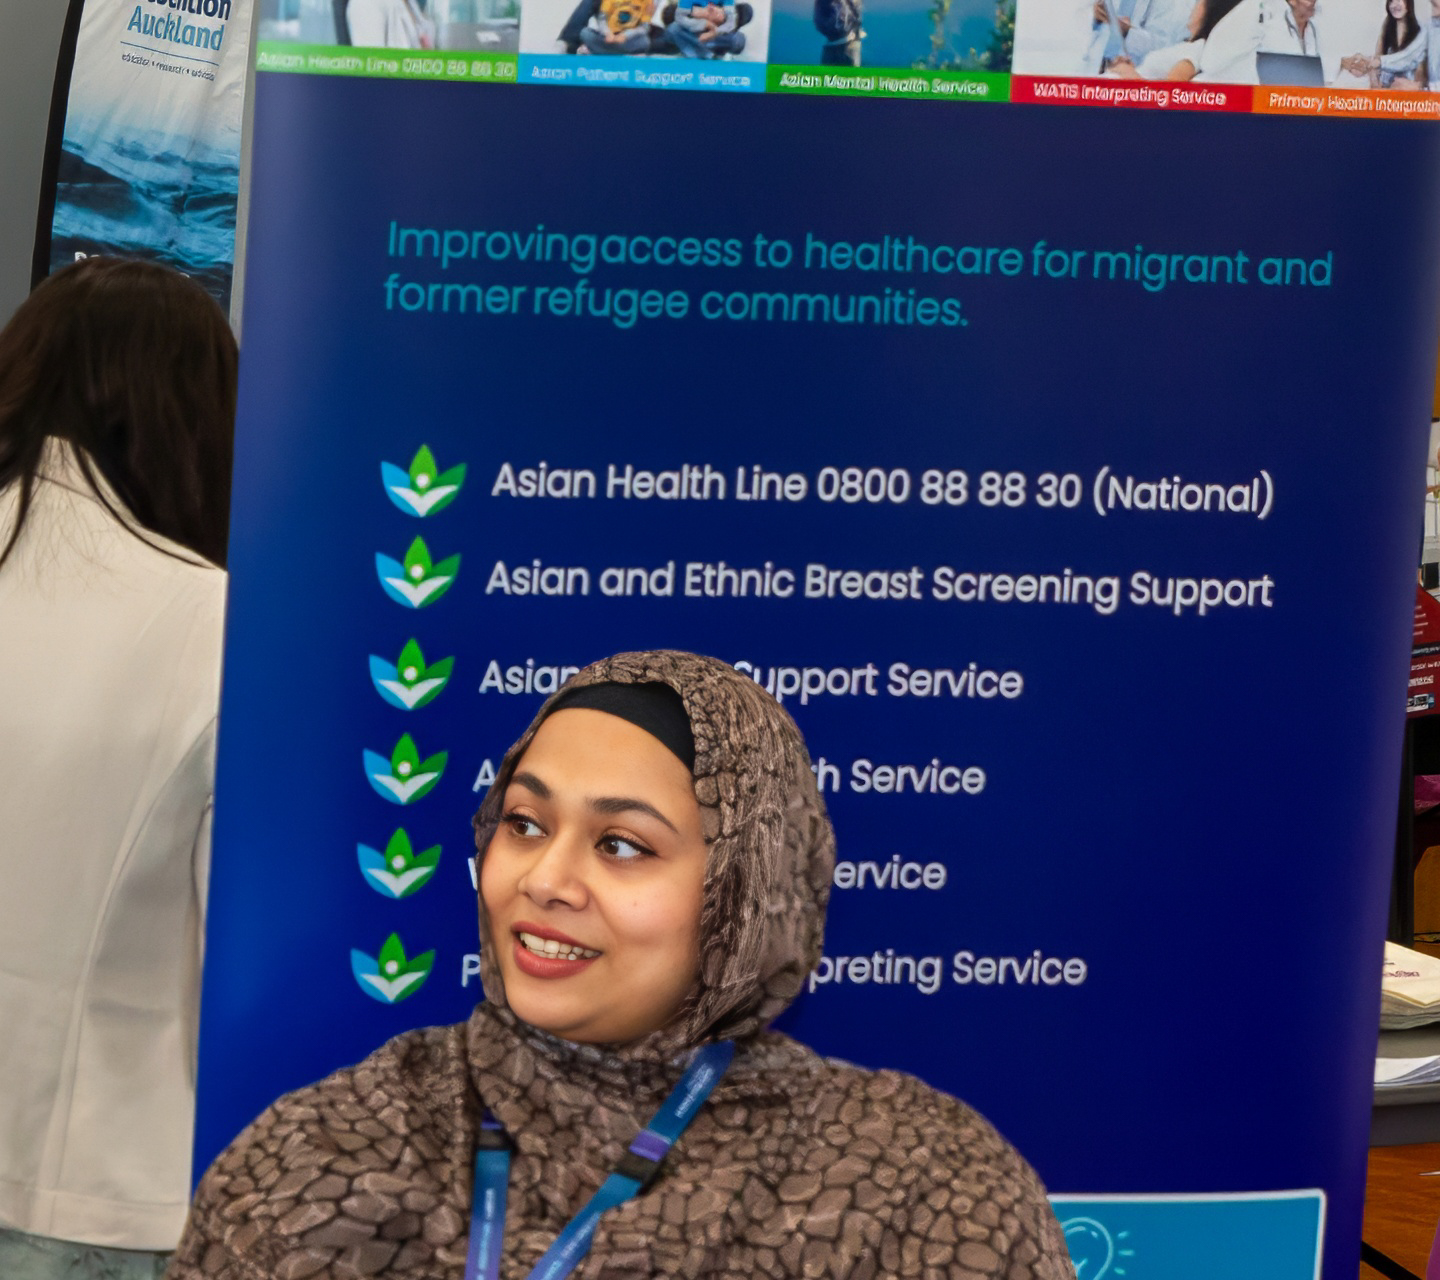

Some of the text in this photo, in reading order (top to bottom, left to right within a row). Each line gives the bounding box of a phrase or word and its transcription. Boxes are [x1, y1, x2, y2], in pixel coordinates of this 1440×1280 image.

[127, 6, 226, 52] Auckland
[1171, 89, 1227, 106] Service
[1269, 92, 1324, 112] Primary
[387, 220, 1333, 294] Improving access to healthcare for migrant and
[384, 273, 969, 329] former refugee communities.
[491, 461, 1274, 520] Asian Health Line 0800 88 88 30 (National)
[485, 559, 1275, 617] Asian and Ethnic Breast Screening Support
[886, 660, 1024, 699] Service
[850, 759, 986, 795] Service
[953, 949, 1087, 987] Service
